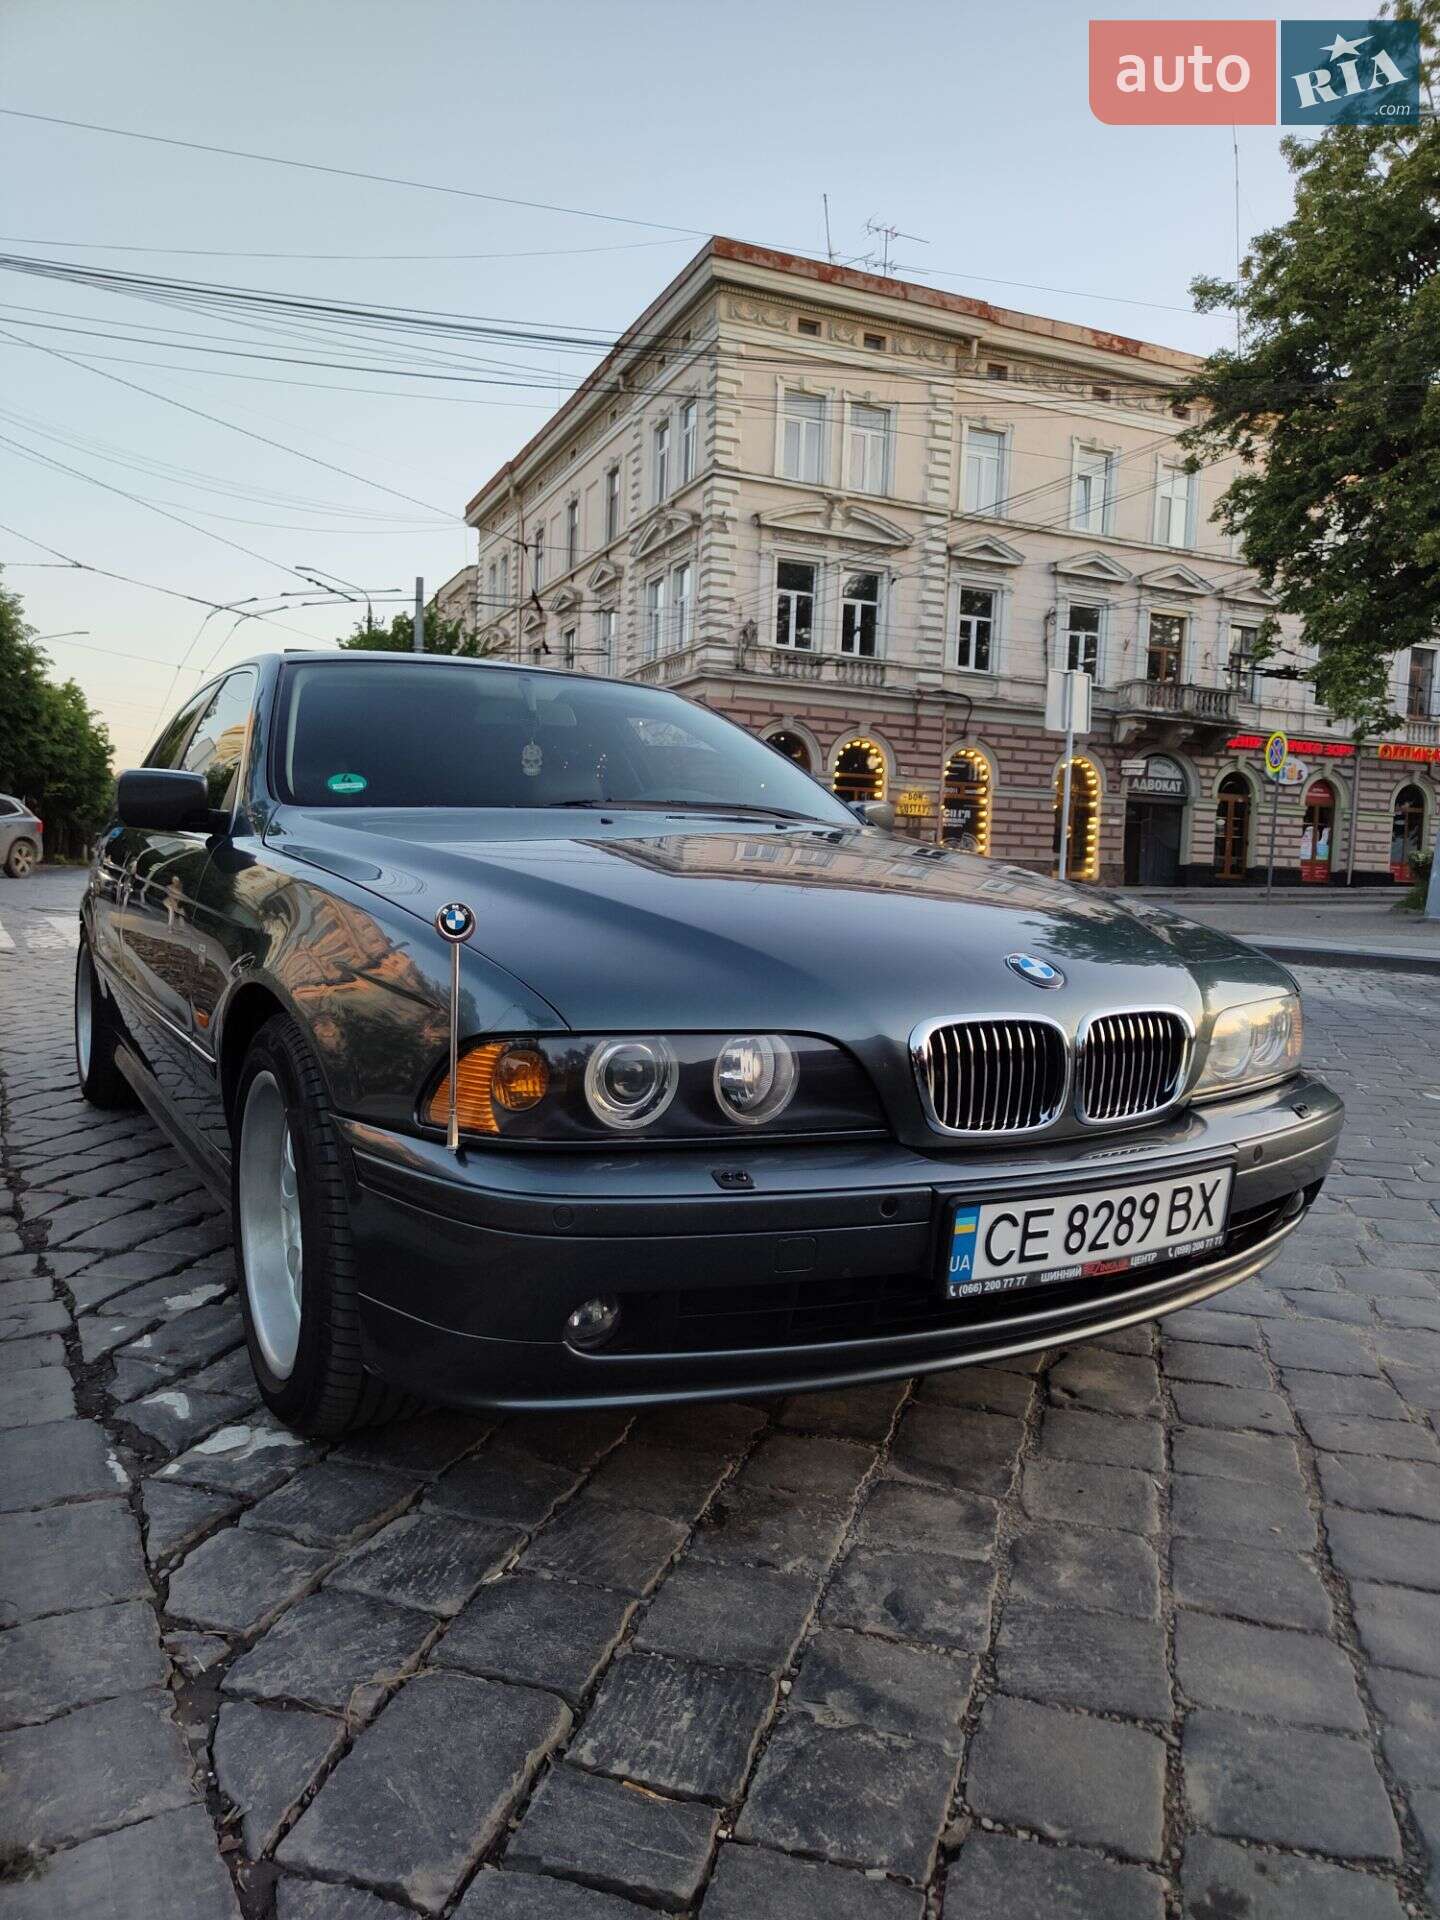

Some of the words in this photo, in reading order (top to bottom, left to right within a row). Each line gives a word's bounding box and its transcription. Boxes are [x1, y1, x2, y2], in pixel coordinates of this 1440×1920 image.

[1132, 778, 1182, 792] АДВОКАТ
[984, 1208, 1055, 1267] CE
[1064, 1191, 1160, 1256] 8289
[1166, 1179, 1222, 1237] BX
[950, 1255, 970, 1273] UA
[1130, 1252, 1158, 1267] ЦЕНТР
[1040, 1265, 1082, 1282] ШИННИЙ
[985, 1280, 1001, 1291] 200
[1003, 1277, 1013, 1288] 77
[1016, 1275, 1028, 1287] 77
